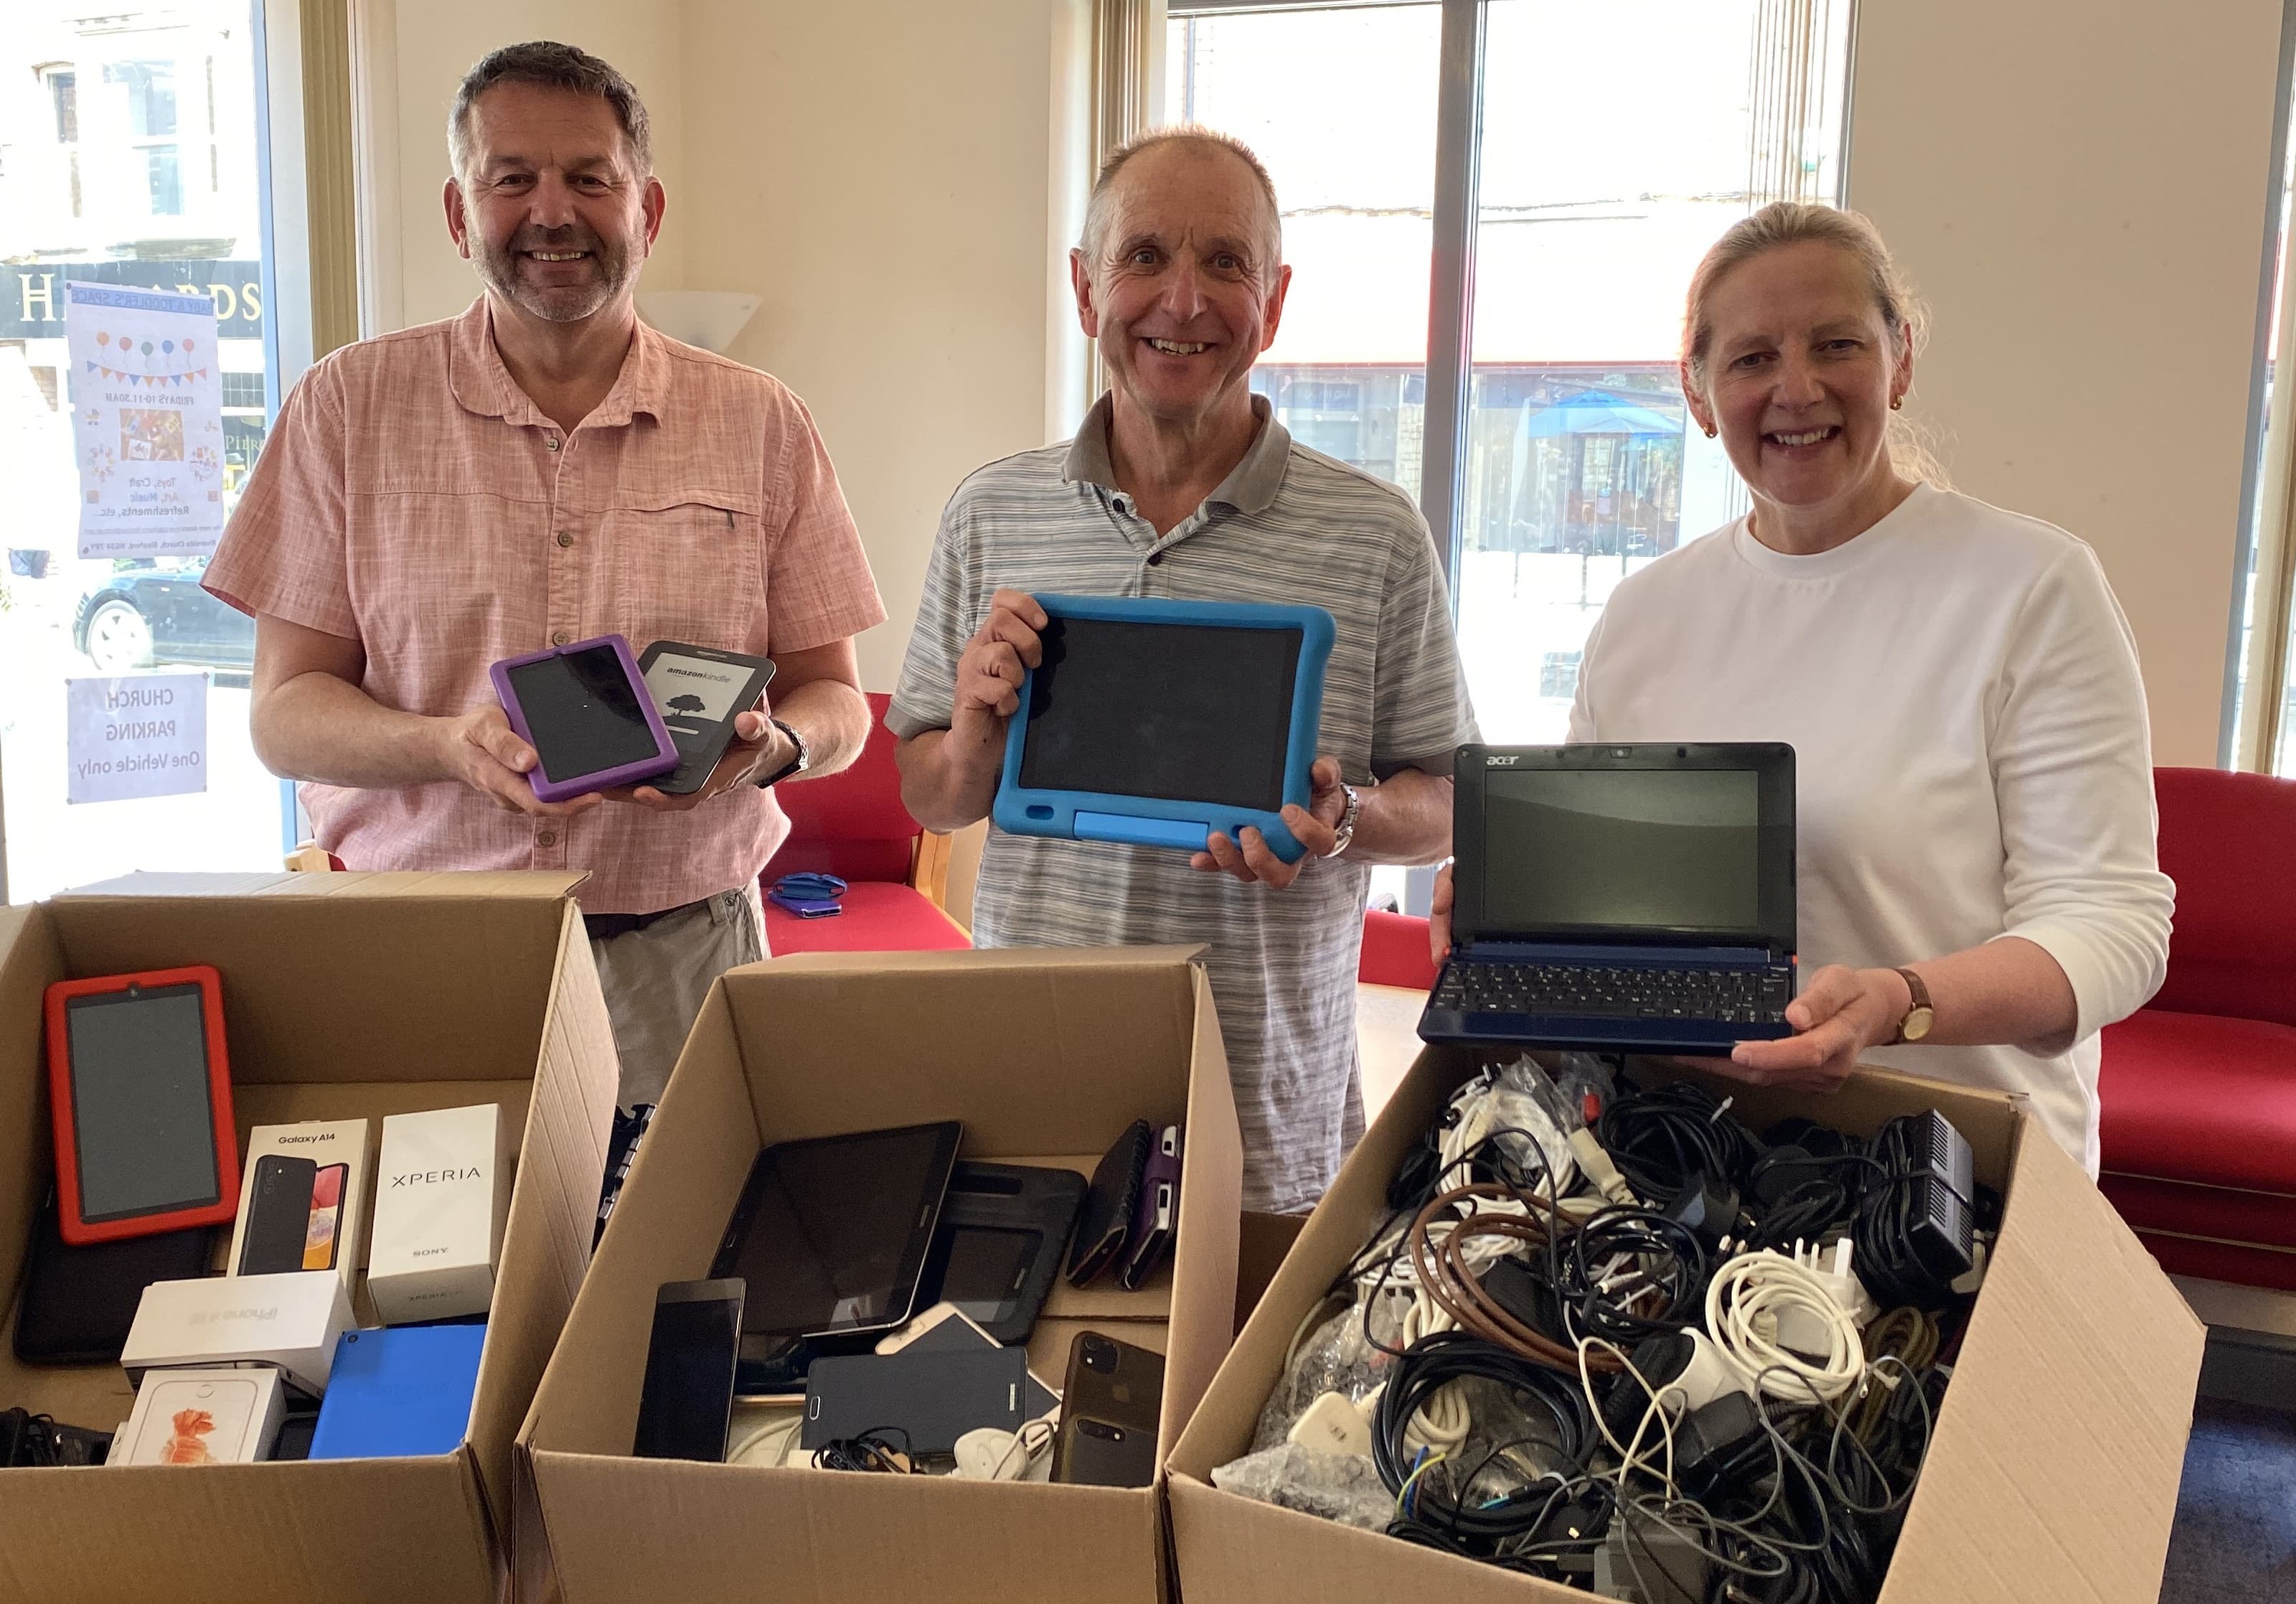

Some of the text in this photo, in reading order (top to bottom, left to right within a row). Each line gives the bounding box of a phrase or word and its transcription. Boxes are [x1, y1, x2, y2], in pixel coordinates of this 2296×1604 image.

[1486, 756, 1520, 766] acer
[278, 1135, 318, 1144] Galaxy
[391, 1167, 481, 1188] XPERIA
[413, 1247, 448, 1257] SONY
